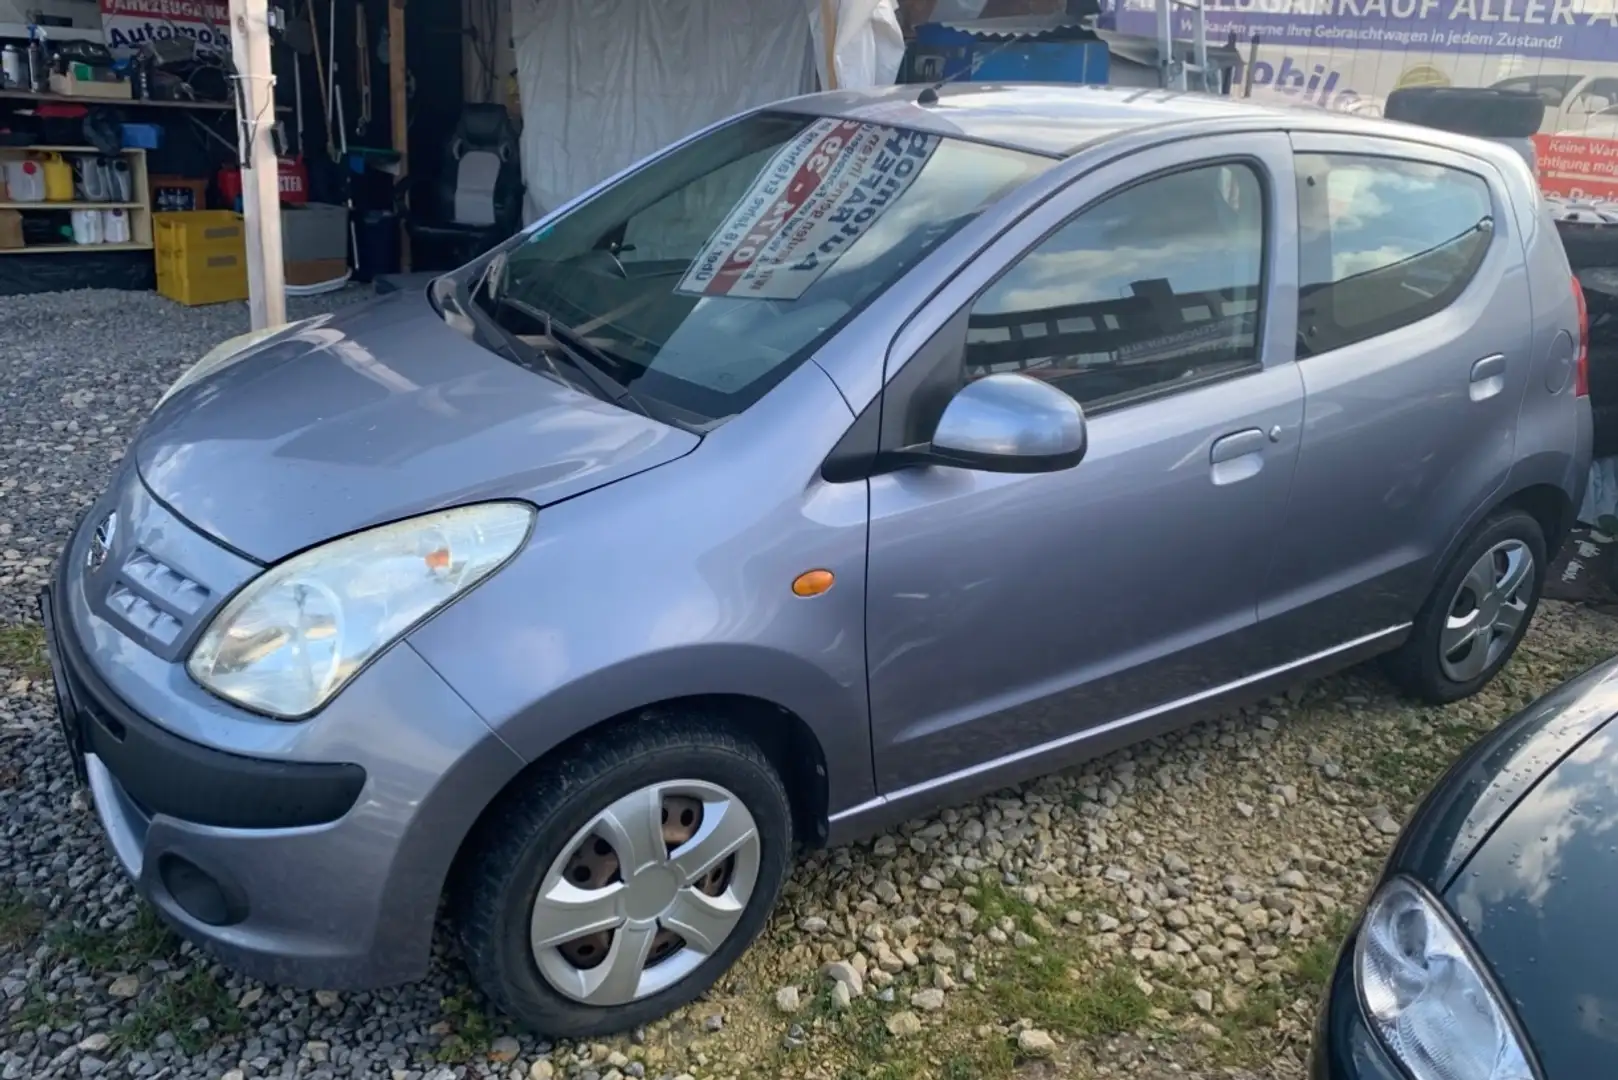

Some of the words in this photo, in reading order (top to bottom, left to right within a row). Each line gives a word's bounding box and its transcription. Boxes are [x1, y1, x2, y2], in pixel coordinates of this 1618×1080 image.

[1247, 24, 1284, 36] gerne
[1314, 25, 1428, 45] Gebrauchtwagen
[1430, 28, 1445, 44] in
[1445, 30, 1493, 46] jedem
[1495, 32, 1563, 49] Zustand!
[1549, 139, 1586, 154] Keine
